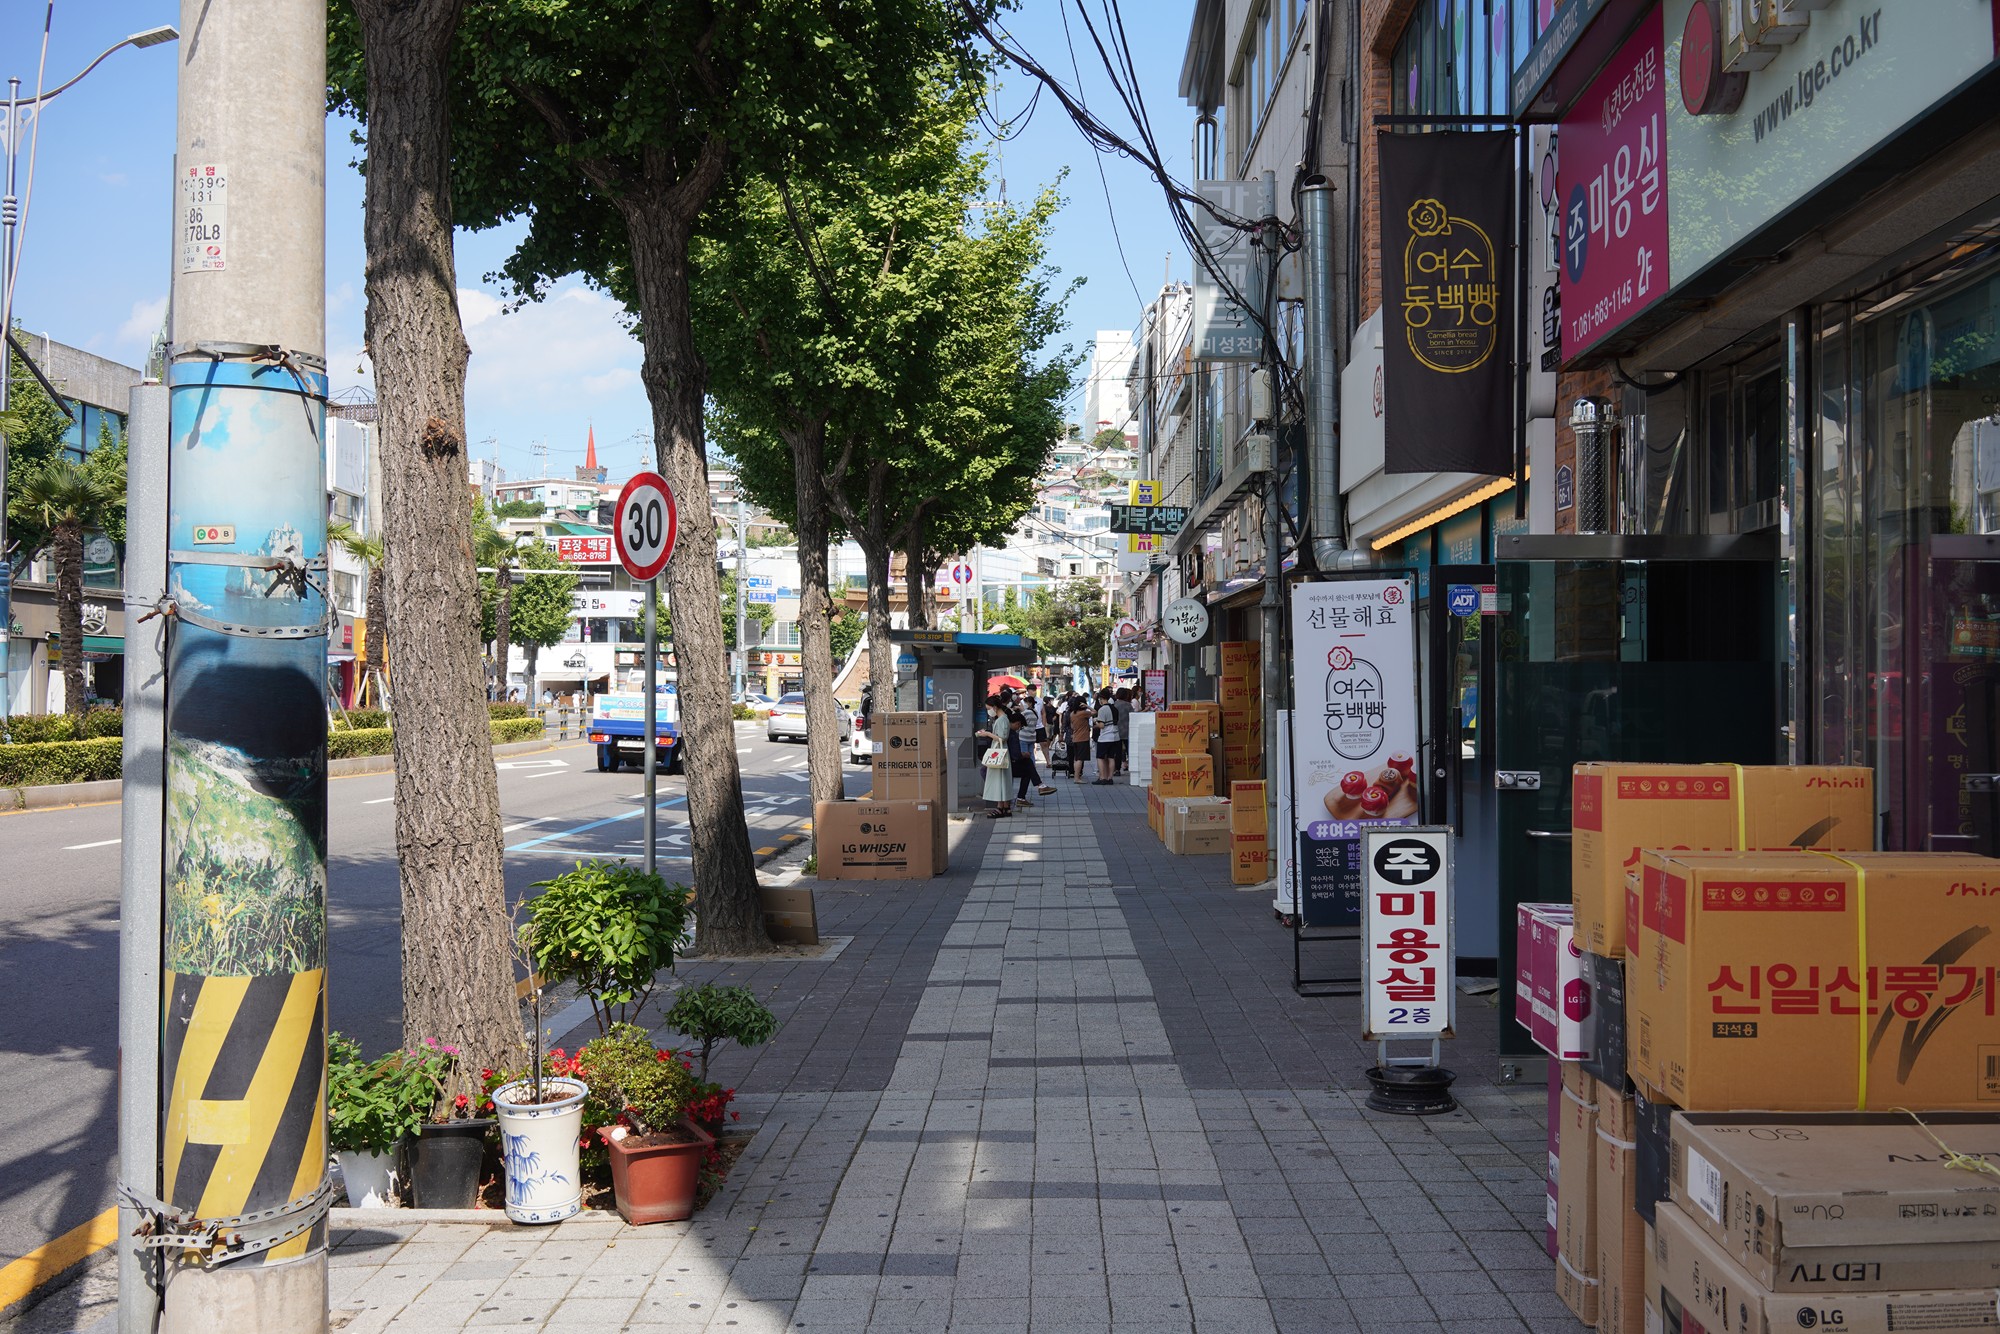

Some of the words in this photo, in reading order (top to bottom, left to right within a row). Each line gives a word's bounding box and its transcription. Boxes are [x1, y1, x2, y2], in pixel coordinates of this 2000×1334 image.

[1753, 8, 1882, 144] www.lge.co.kr
[1611, 46, 1657, 128] 컷트전문
[1568, 199, 1586, 270] 주
[1589, 112, 1660, 250] 미용실
[189, 207, 203, 224] 86
[189, 224, 221, 242] 78L8
[1202, 185, 1250, 329] 가전랜드
[1416, 247, 1484, 281] 여수
[1572, 279, 1632, 343] T.061-663-1145
[1637, 245, 1653, 298] 2F
[1400, 283, 1501, 328] 동백빵
[1558, 486, 1570, 504] 66-1
[628, 498, 662, 553] 30
[1112, 507, 1185, 532] 거북선빵
[223, 530, 229, 538] B
[1453, 594, 1475, 607] ADT
[1168, 611, 1199, 626] 거북선
[1306, 605, 1397, 629] 선물해효
[1183, 625, 1198, 638] 빵
[1333, 678, 1375, 700] 여수
[1323, 701, 1387, 730] 동백빵
[904, 737, 918, 747] LG
[878, 761, 932, 769] REFRIGERATOR
[873, 824, 886, 832] LG
[842, 844, 857, 854] LG
[859, 843, 906, 856] WHISEN
[1239, 850, 1268, 863] 신일
[1384, 847, 1430, 880] 주
[1375, 890, 1440, 1002] 미용실
[1707, 963, 1995, 1019] 신일선풍기
[1387, 1007, 1431, 1024] 2층
[1717, 1024, 1754, 1037] 좌석용
[1748, 1128, 1809, 1141] 80
[1744, 1190, 1752, 1224] LED
[1793, 1205, 1810, 1214] cm
[1789, 1263, 1827, 1283] TV
[1832, 1262, 1881, 1282] LED
[1821, 1310, 1844, 1325] LG
